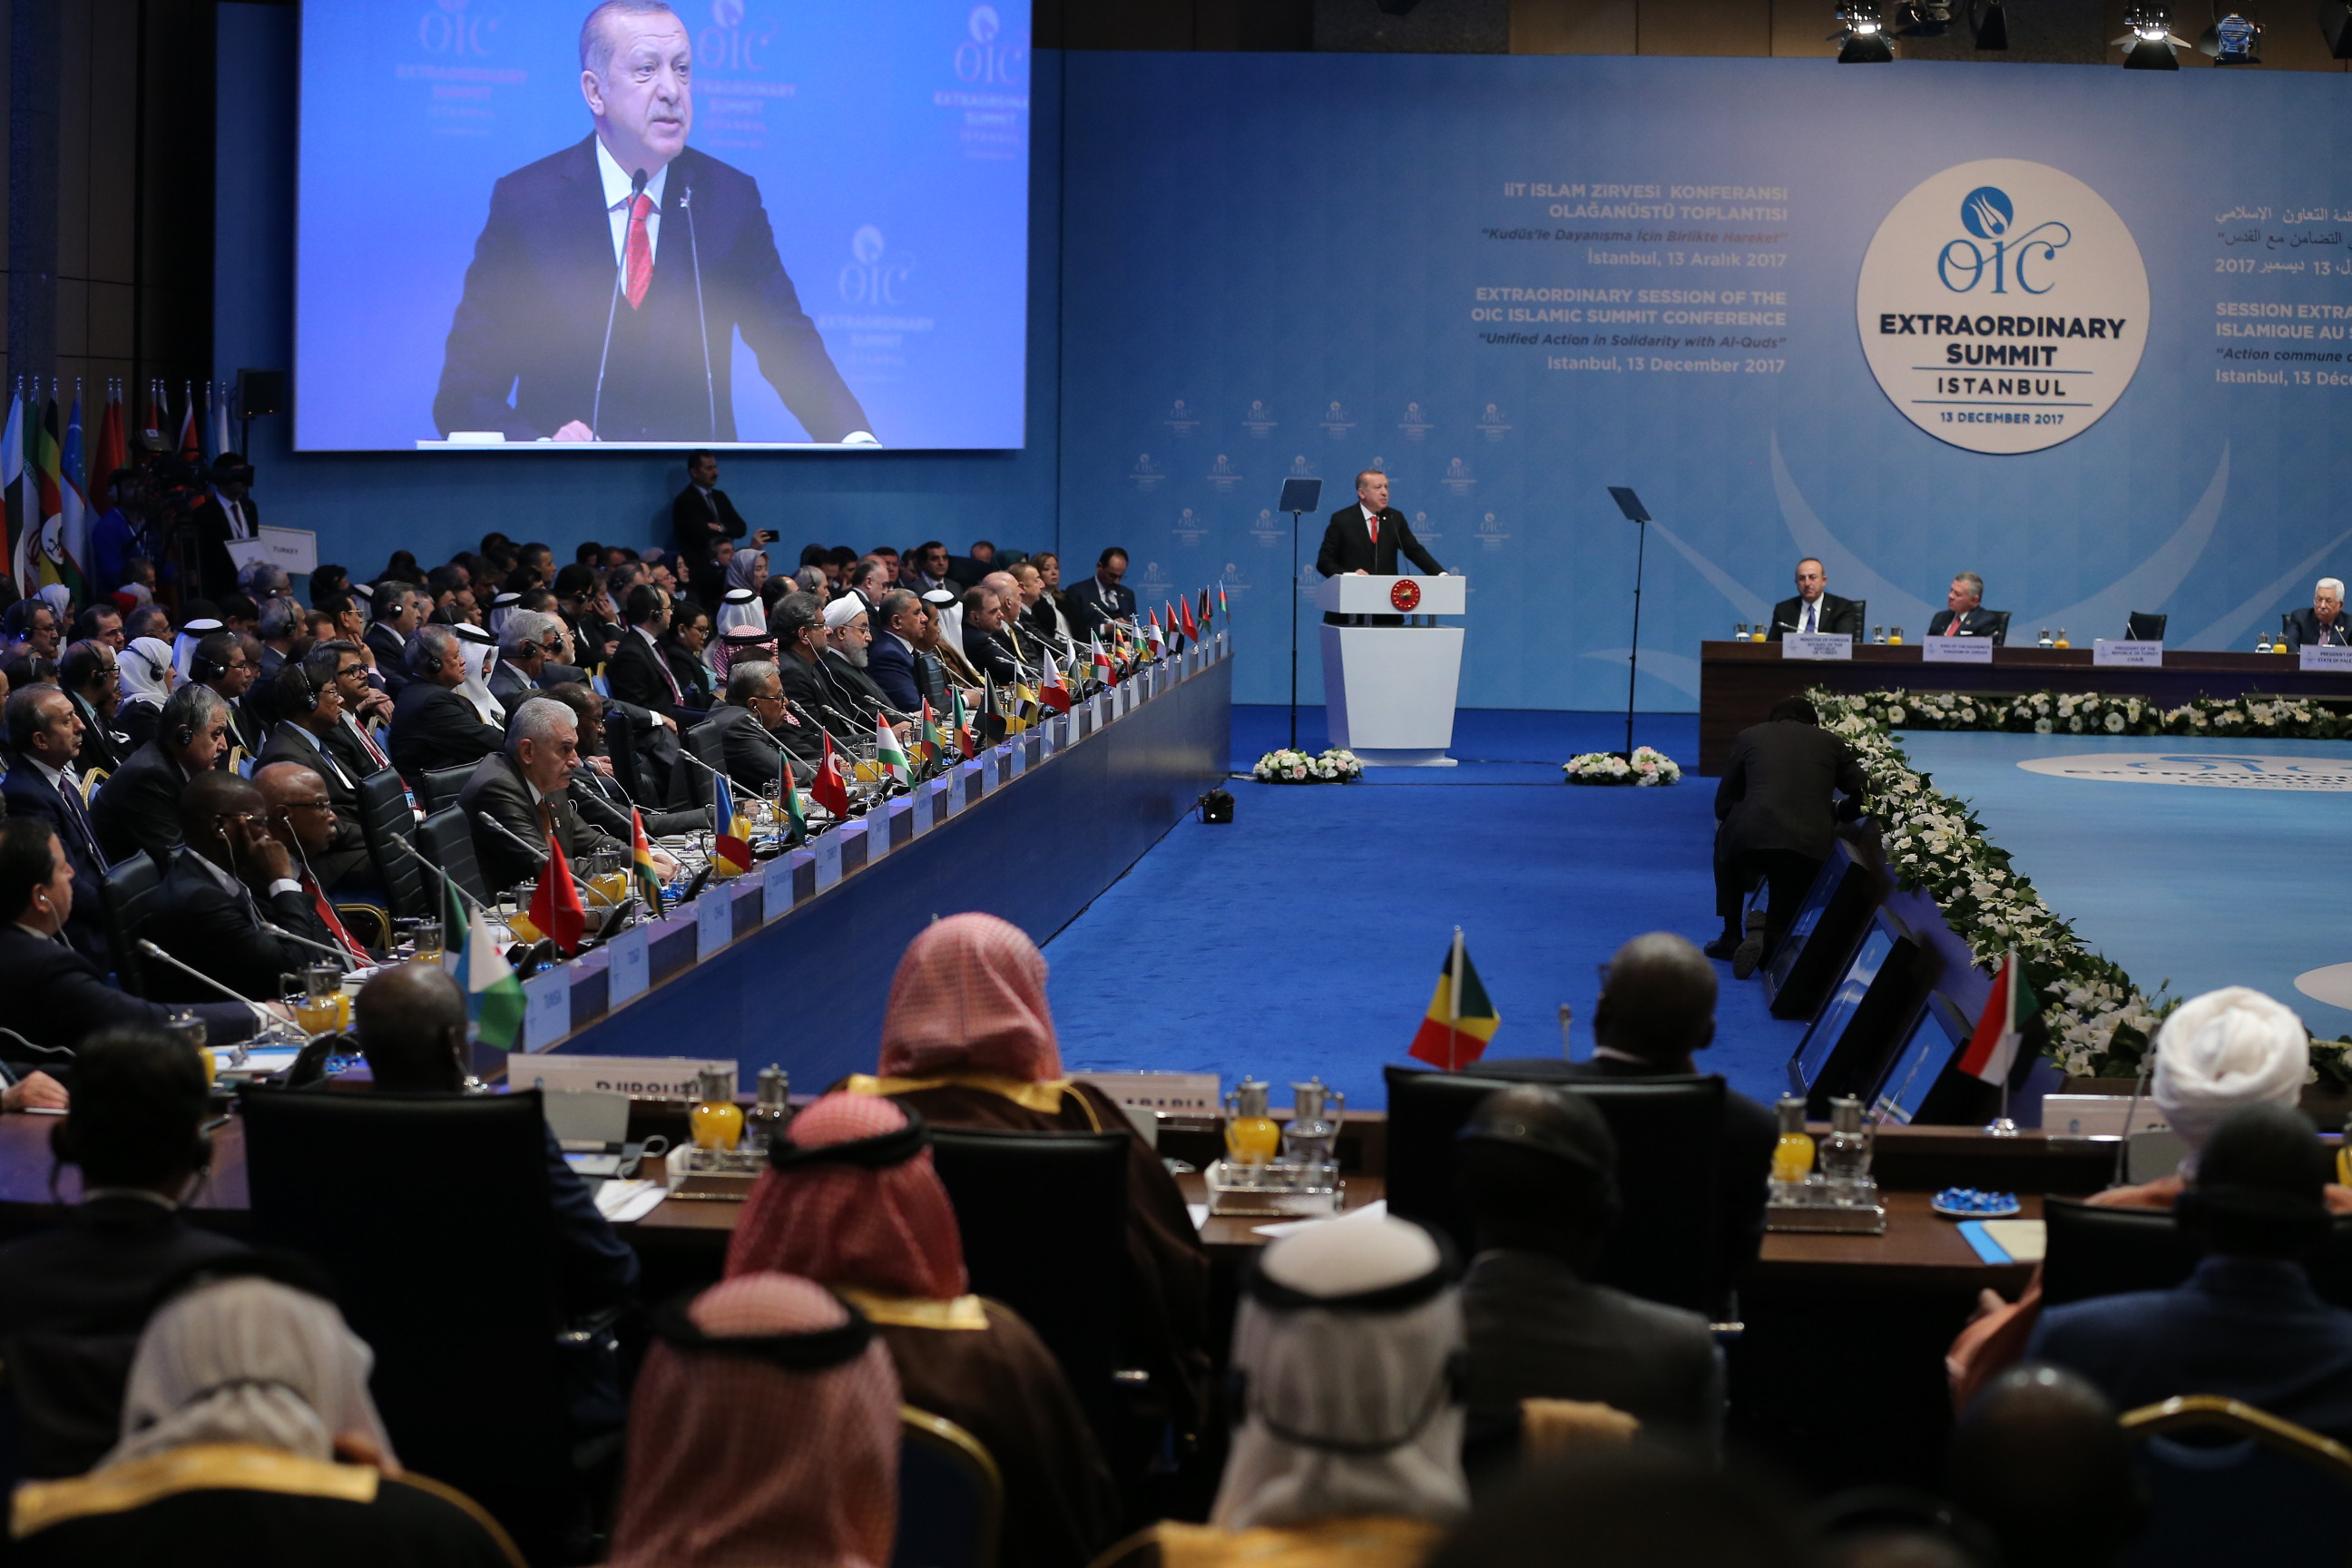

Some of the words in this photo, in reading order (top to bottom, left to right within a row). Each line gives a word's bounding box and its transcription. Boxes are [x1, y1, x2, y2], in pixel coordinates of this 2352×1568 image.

[1670, 185, 1788, 201] KONFERANSI
[1549, 201, 1675, 220] OLAĞANÜSTÜ
[1680, 205, 1788, 221] TOPLANTISI
[2215, 204, 2272, 225] الإسلامي
[2282, 206, 2328, 224] التعاون
[1554, 229, 1632, 242] Dayanışma
[1667, 230, 1719, 242] Birlikte
[2266, 234, 2285, 250] مع
[2289, 230, 2342, 248] التضامن
[1588, 247, 1661, 268] İstanbul,
[1667, 251, 1685, 266] 13
[1690, 251, 1740, 267] Aralık
[1746, 253, 1788, 268] 2017
[1937, 221, 2071, 295] OIC
[2214, 258, 2256, 273] 2017
[2258, 259, 2305, 275] ديسمبر
[2313, 260, 2331, 276] 13
[1476, 287, 1633, 303] EXTRAORDINARY
[1638, 289, 1716, 304] SESSION
[1720, 290, 1746, 305] OF
[1750, 291, 1787, 306] THE
[1471, 307, 1504, 322] OIC
[1508, 308, 1583, 323] ISLAMIC
[1587, 309, 1659, 324] SUMMIT
[1662, 310, 1787, 326] CONFERENCE
[2216, 301, 2293, 318] SESSION
[1879, 313, 2126, 339] EXTRAORDINARY
[2216, 322, 2314, 339] ISLAMIQUE
[2318, 325, 2345, 340] AU
[1542, 334, 1589, 346] Action
[1593, 334, 1606, 346] in
[1611, 334, 1681, 349] Solidarity
[1685, 336, 1716, 348] with
[1946, 343, 2058, 367] SUMMIT
[2274, 349, 2343, 362] commune
[1547, 356, 1622, 373] Istanbul,
[1627, 357, 1644, 371] 13
[1651, 358, 1740, 372] December
[1745, 358, 1786, 373] 2017
[2215, 368, 2288, 387] Istanbul,
[2293, 370, 2311, 385] 13
[1937, 377, 2067, 397] ISTANBUL
[1940, 411, 1953, 424] 13
[1958, 412, 2031, 424] DECEMBER
[2034, 414, 2064, 426] 2017
[273, 545, 299, 555] TURKEY
